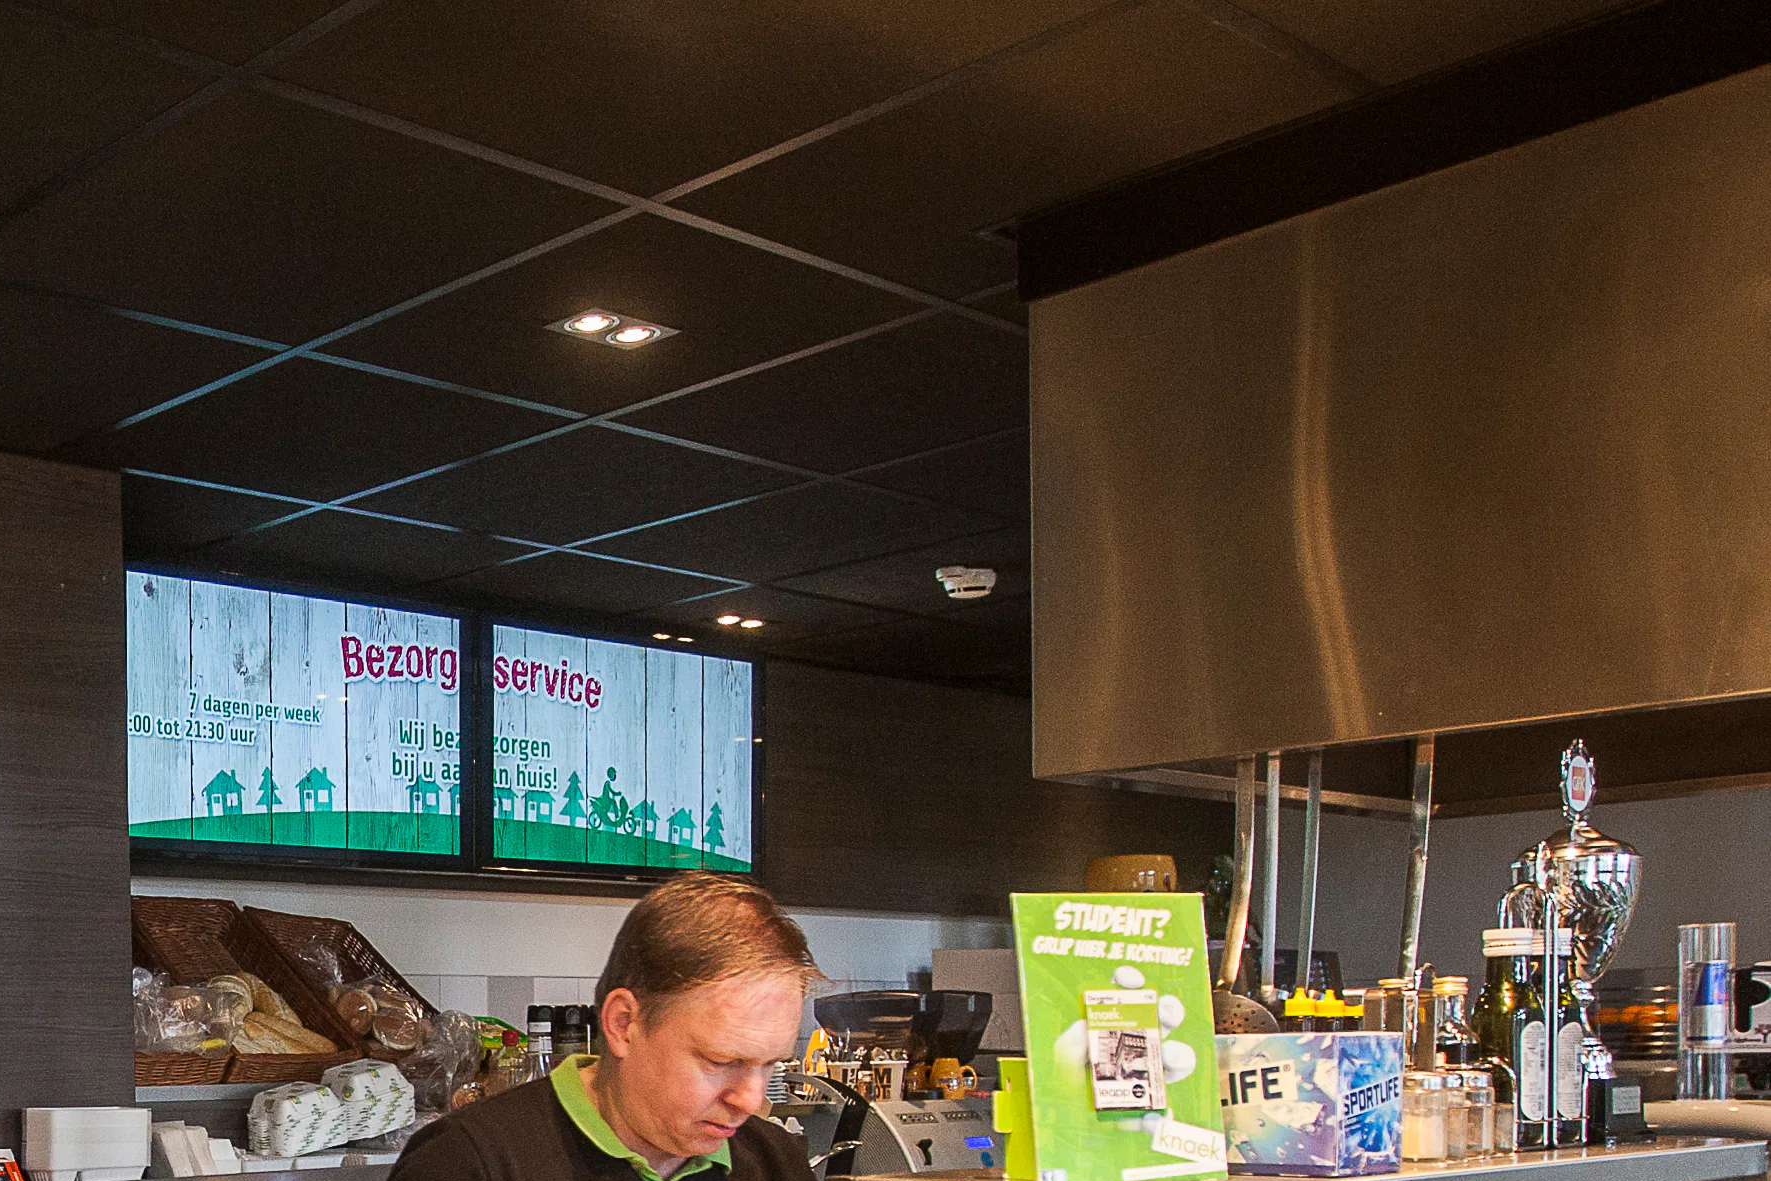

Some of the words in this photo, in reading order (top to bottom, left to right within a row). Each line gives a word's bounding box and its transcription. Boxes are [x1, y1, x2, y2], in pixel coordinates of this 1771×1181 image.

[340, 636, 458, 691] Bezorg
[493, 655, 602, 709] service
[189, 692, 198, 710] 7
[203, 694, 251, 718] dagen
[256, 703, 280, 720] per
[284, 706, 321, 723] week
[157, 718, 180, 736] tot
[185, 719, 225, 741] 21:30
[230, 727, 255, 743] uur
[399, 720, 426, 751] Wij
[392, 752, 416, 783] bij
[423, 762, 434, 779] u
[516, 764, 558, 790] huis!
[1054, 901, 1172, 939] STUDENT?
[1125, 943, 1194, 967] KORTING!
[1343, 1076, 1400, 1117] SPORTLIFE
